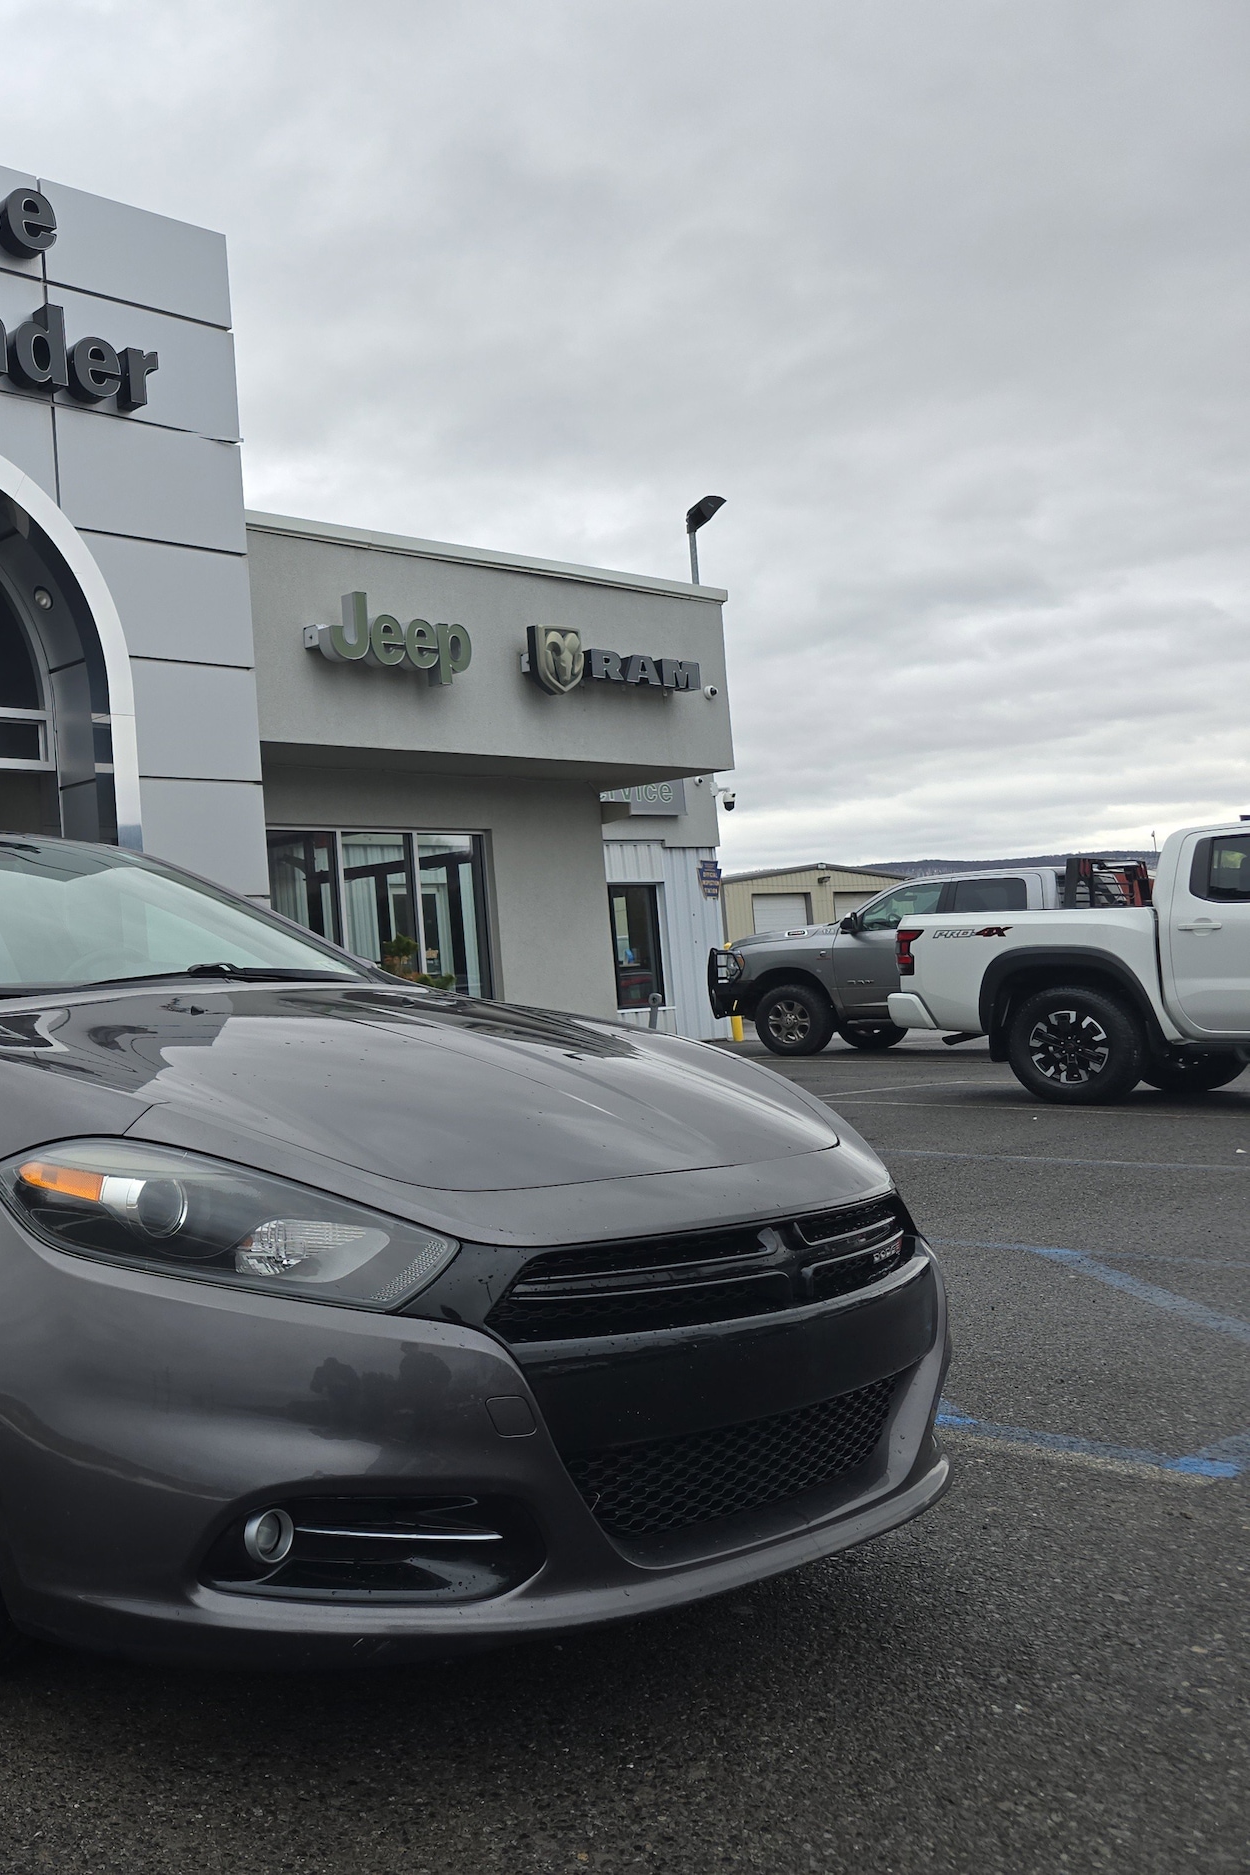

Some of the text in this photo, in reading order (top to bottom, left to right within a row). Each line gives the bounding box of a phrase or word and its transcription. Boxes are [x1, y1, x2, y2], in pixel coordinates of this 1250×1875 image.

[318, 591, 472, 687] Jeep
[584, 648, 701, 691] RAM
[933, 926, 1014, 939] PRO-4X
